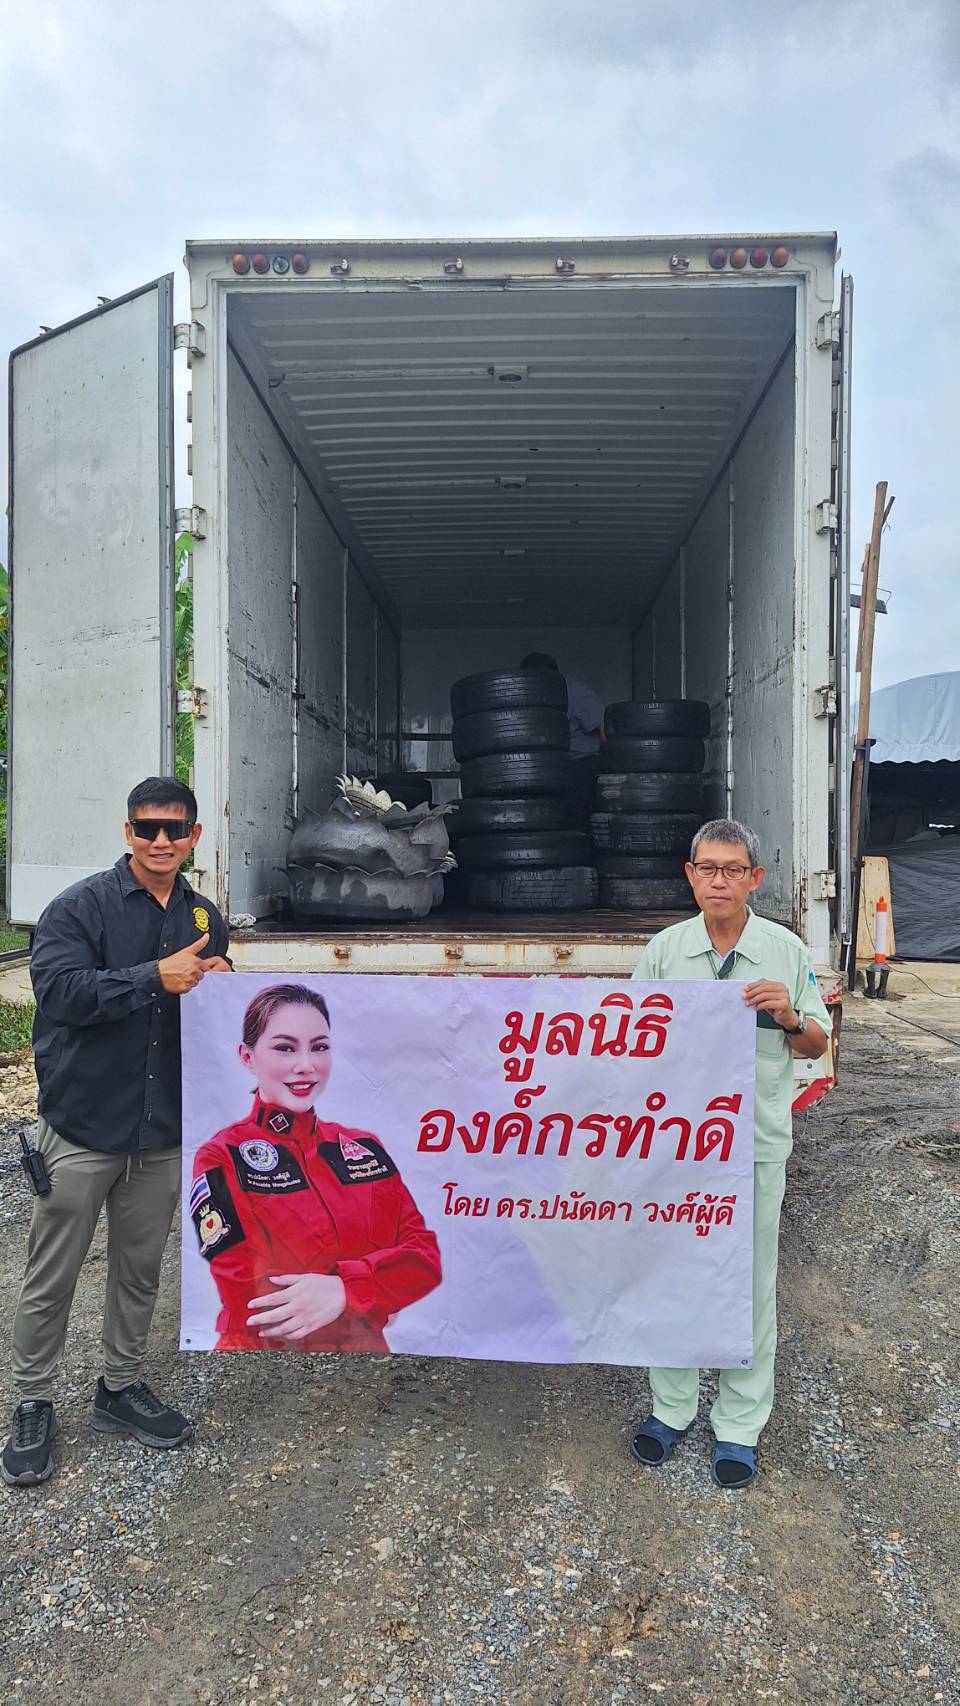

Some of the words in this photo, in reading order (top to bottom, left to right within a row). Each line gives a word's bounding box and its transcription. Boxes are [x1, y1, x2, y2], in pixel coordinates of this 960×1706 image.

[498, 992, 674, 1083] มูลนิธิ
[416, 1084, 743, 1163] องค์กรทำดี
[442, 1183, 490, 1218] โดย
[496, 1191, 633, 1223] ดร.ปนัดดา
[643, 1192, 738, 1237] วงศ์ผู้ดี
